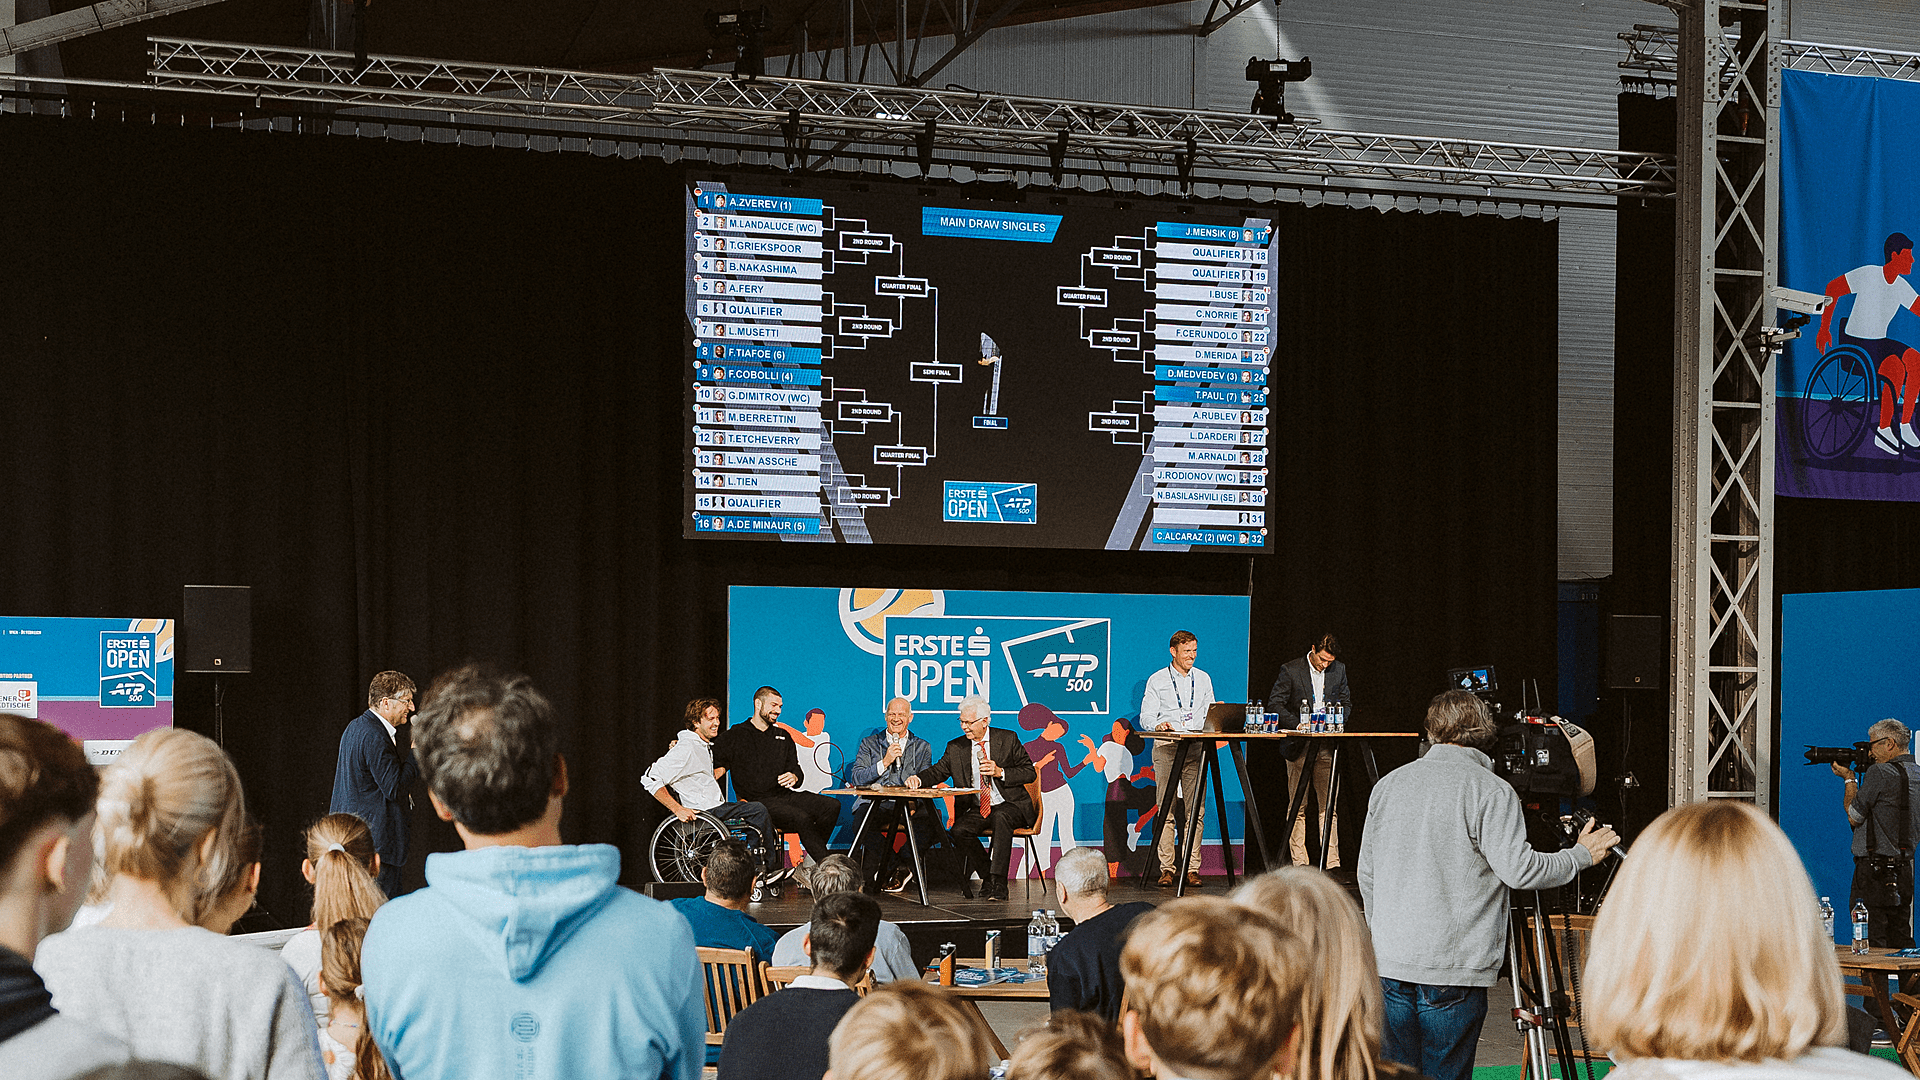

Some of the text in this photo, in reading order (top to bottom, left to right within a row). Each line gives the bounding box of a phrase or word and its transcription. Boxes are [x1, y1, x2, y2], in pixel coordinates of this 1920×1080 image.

[704, 196, 792, 212] 1 A.ZVEREV (1)
[703, 218, 817, 234] 2 M.LANDALUCE (WC)
[941, 217, 1046, 232] MAIN DRAW SINGLES
[1186, 228, 1265, 240] J.MENSIK (8) 17
[703, 239, 801, 253] 3 T.GRIEKSPOOR
[1192, 248, 1265, 260] QUALIFIER 18
[702, 261, 797, 274] 4 B.NAKASHIMA
[1192, 268, 1265, 281] QUALIFIER 19
[702, 282, 764, 294] 5 A.FERY
[1210, 290, 1265, 301] I.BUSE 20
[702, 304, 783, 317] 6 QUALIFIER
[1196, 310, 1265, 322] C.NORRIE 21
[702, 325, 779, 338] 7 L.MUSETTI
[1176, 329, 1265, 342] F.CERUNDOLO 22
[702, 347, 785, 360] 8 F.TIAFOE (6)
[1196, 351, 1265, 362] D.MERIDA 23
[702, 369, 793, 382] 9 F.COBOLLI (4)
[1168, 369, 1264, 382] D.MEDVEDEV (3) 24
[700, 390, 810, 404] 10 G.DIMITROV (WC)
[1195, 391, 1264, 402] T.PAUL (7) 25
[700, 412, 796, 424] 11 M.BERRETTINI
[1193, 412, 1263, 422] A.RUBLEV 26
[700, 434, 800, 446] 12 T.ETCHEVERRY
[1190, 432, 1263, 442] L.DARDERI 27
[699, 455, 797, 466] 13 L.VAN ASSCHE
[1189, 452, 1263, 463] M.ARNALDI 28
[699, 476, 758, 486] 14 L.TIEN
[1158, 471, 1262, 483] J.RODIONOV (WC) 29
[949, 490, 976, 498] ERSTE
[1157, 491, 1262, 503] N.BASILASHVILI (SE) 30
[699, 498, 781, 510] 15 QUALIFIER
[948, 500, 987, 518] OPEN
[1003, 498, 1032, 508] ATP
[1252, 515, 1262, 523] 31
[699, 520, 805, 532] 16 A.DE MINAUR (5)
[1157, 532, 1262, 544] C.ALCARAZ (2) (WC) 32
[107, 640, 138, 648] ERSTE
[895, 635, 964, 656] ERSTE
[107, 650, 149, 668] OPEN
[1027, 654, 1098, 678] ATP
[894, 659, 990, 703] OPEN
[1065, 679, 1092, 692] 500
[109, 683, 145, 695] ATP
